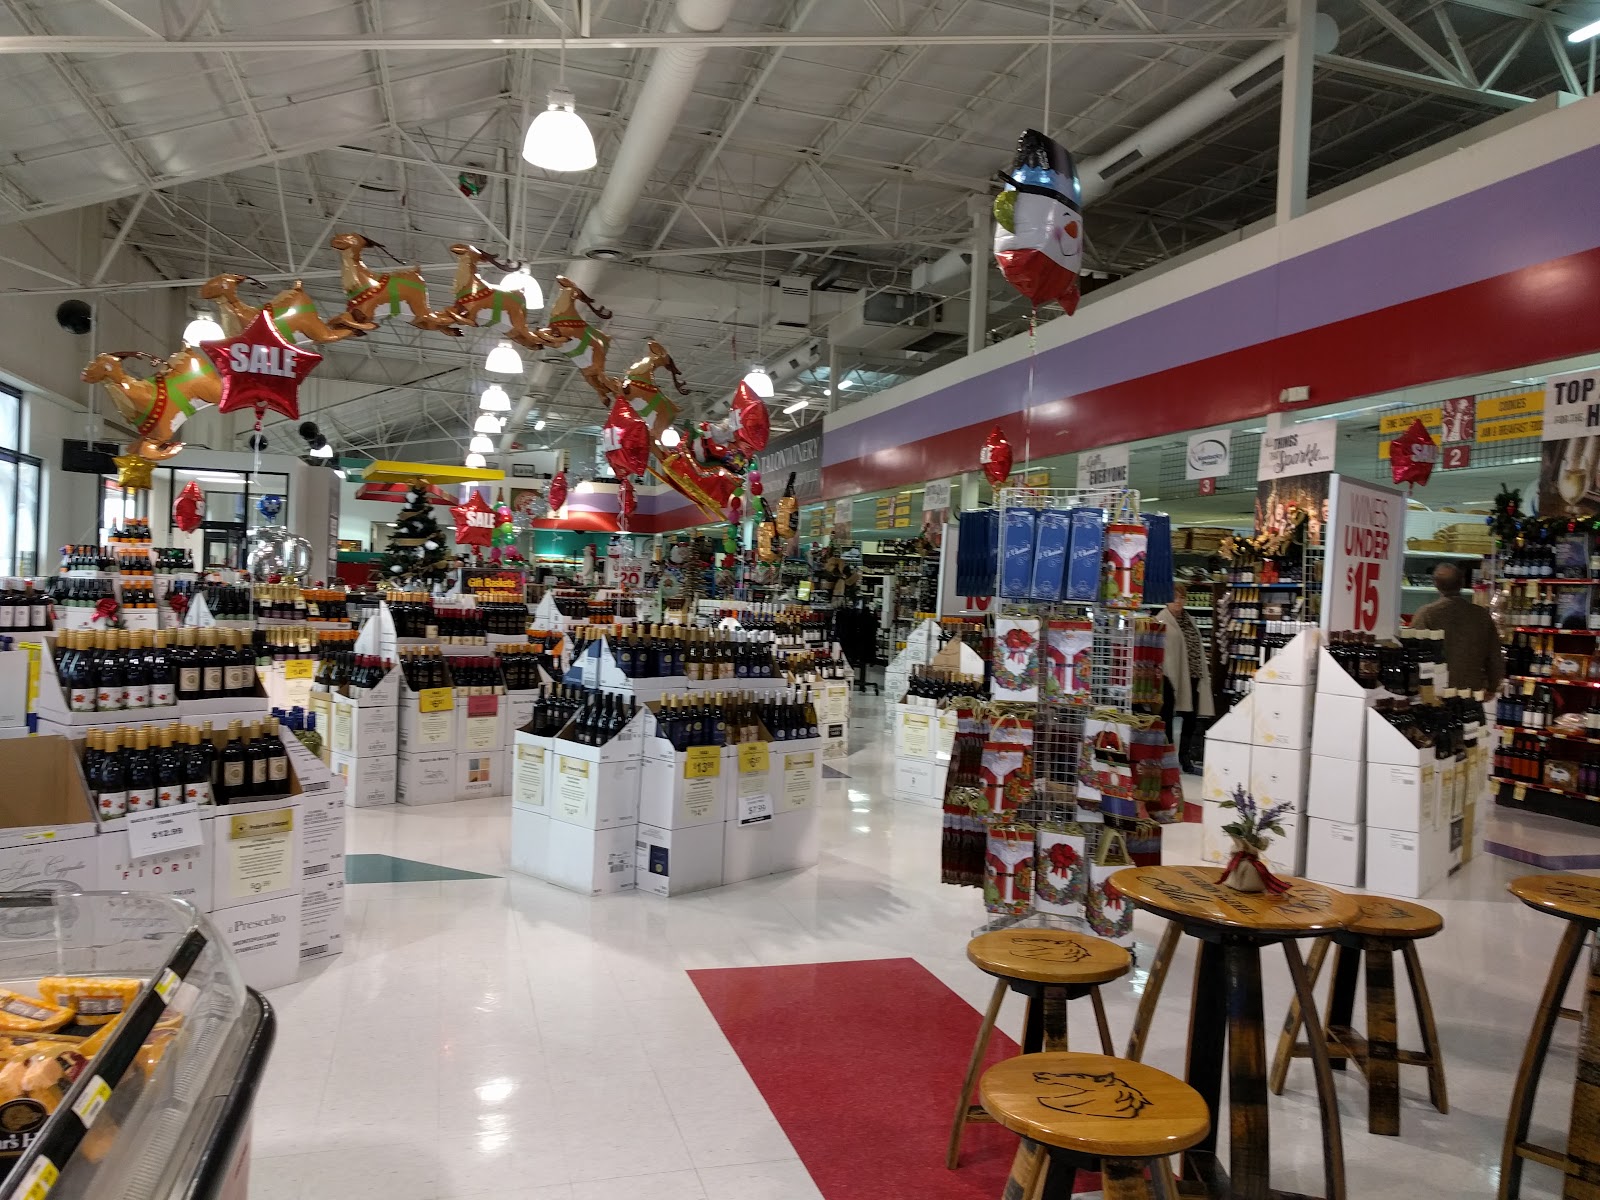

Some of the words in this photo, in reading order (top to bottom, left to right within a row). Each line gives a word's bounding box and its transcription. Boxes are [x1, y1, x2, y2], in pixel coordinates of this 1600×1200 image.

[229, 342, 298, 379] SALE
[1554, 377, 1595, 405] TOP
[1499, 397, 1527, 412] COOKIES
[784, 436, 820, 465] WINERY
[1274, 433, 1299, 450] THINGS
[1450, 448, 1462, 466] 2
[1089, 465, 1127, 486] EVERYONE
[1202, 479, 1210, 493] 3
[465, 511, 496, 529] SALE
[1350, 491, 1389, 529] WINES
[1344, 524, 1390, 560] UNDER
[467, 577, 483, 588] Gift
[484, 577, 516, 588] Baskets
[1346, 561, 1381, 631] $15
[122, 861, 193, 880] FIORI
[234, 913, 287, 933] Prescelto
